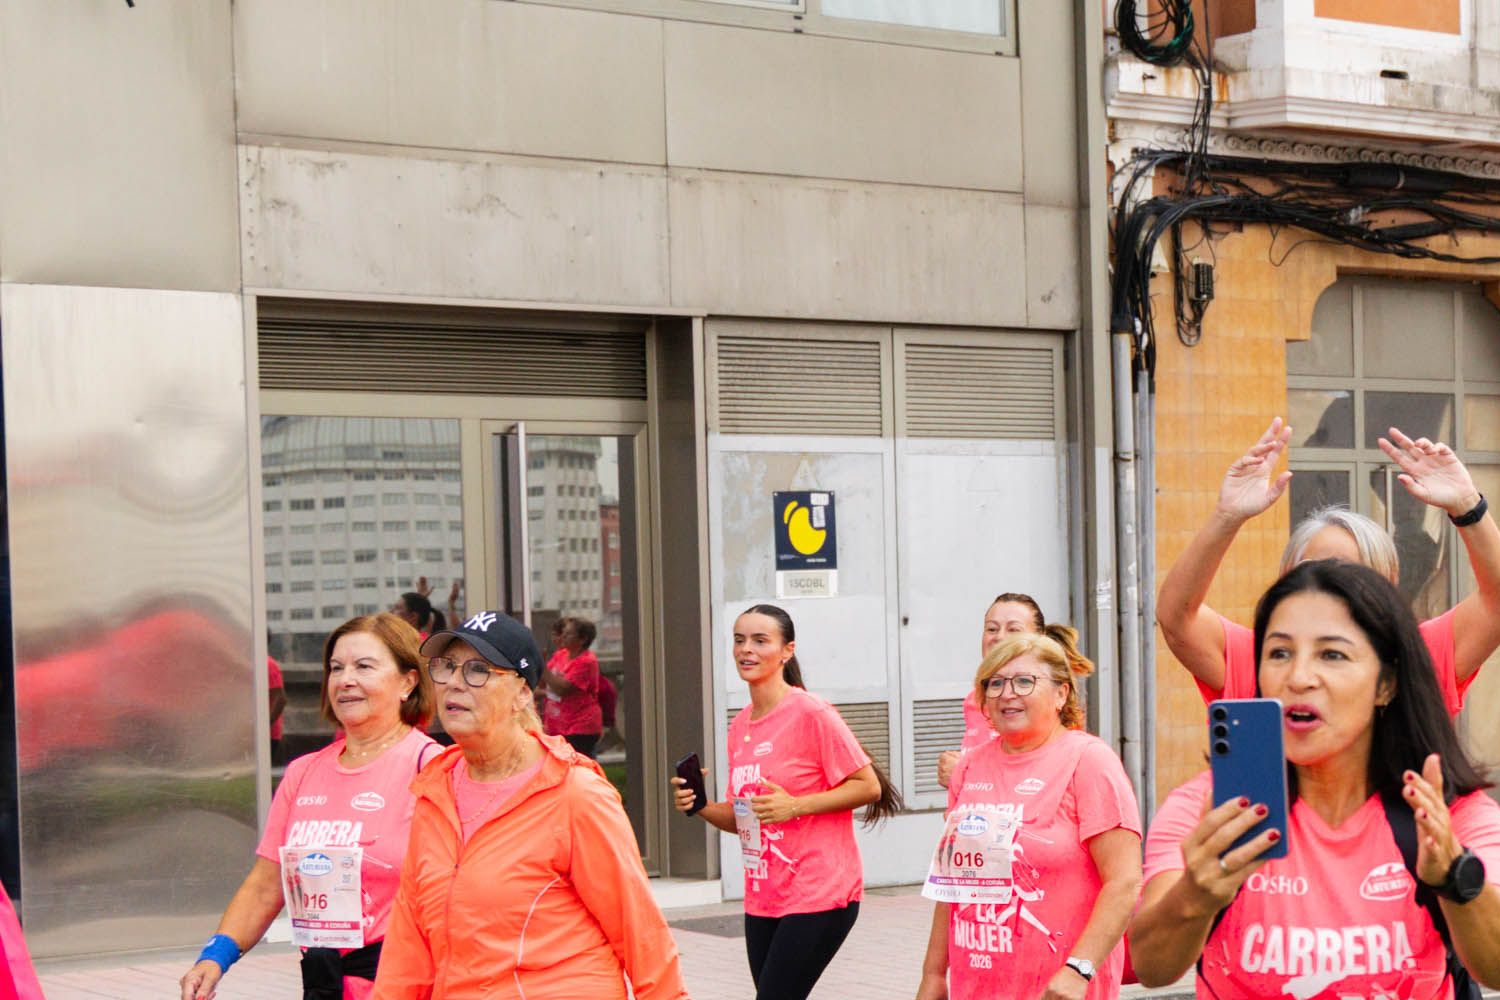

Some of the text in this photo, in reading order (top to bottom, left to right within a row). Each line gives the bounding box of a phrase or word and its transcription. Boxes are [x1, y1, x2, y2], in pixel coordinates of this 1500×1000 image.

[287, 820, 364, 848] CARRERA
[954, 852, 984, 867] 016
[954, 919, 1013, 953] MUJER
[1240, 921, 1417, 976] CARRERA
[969, 953, 993, 969] 2026
